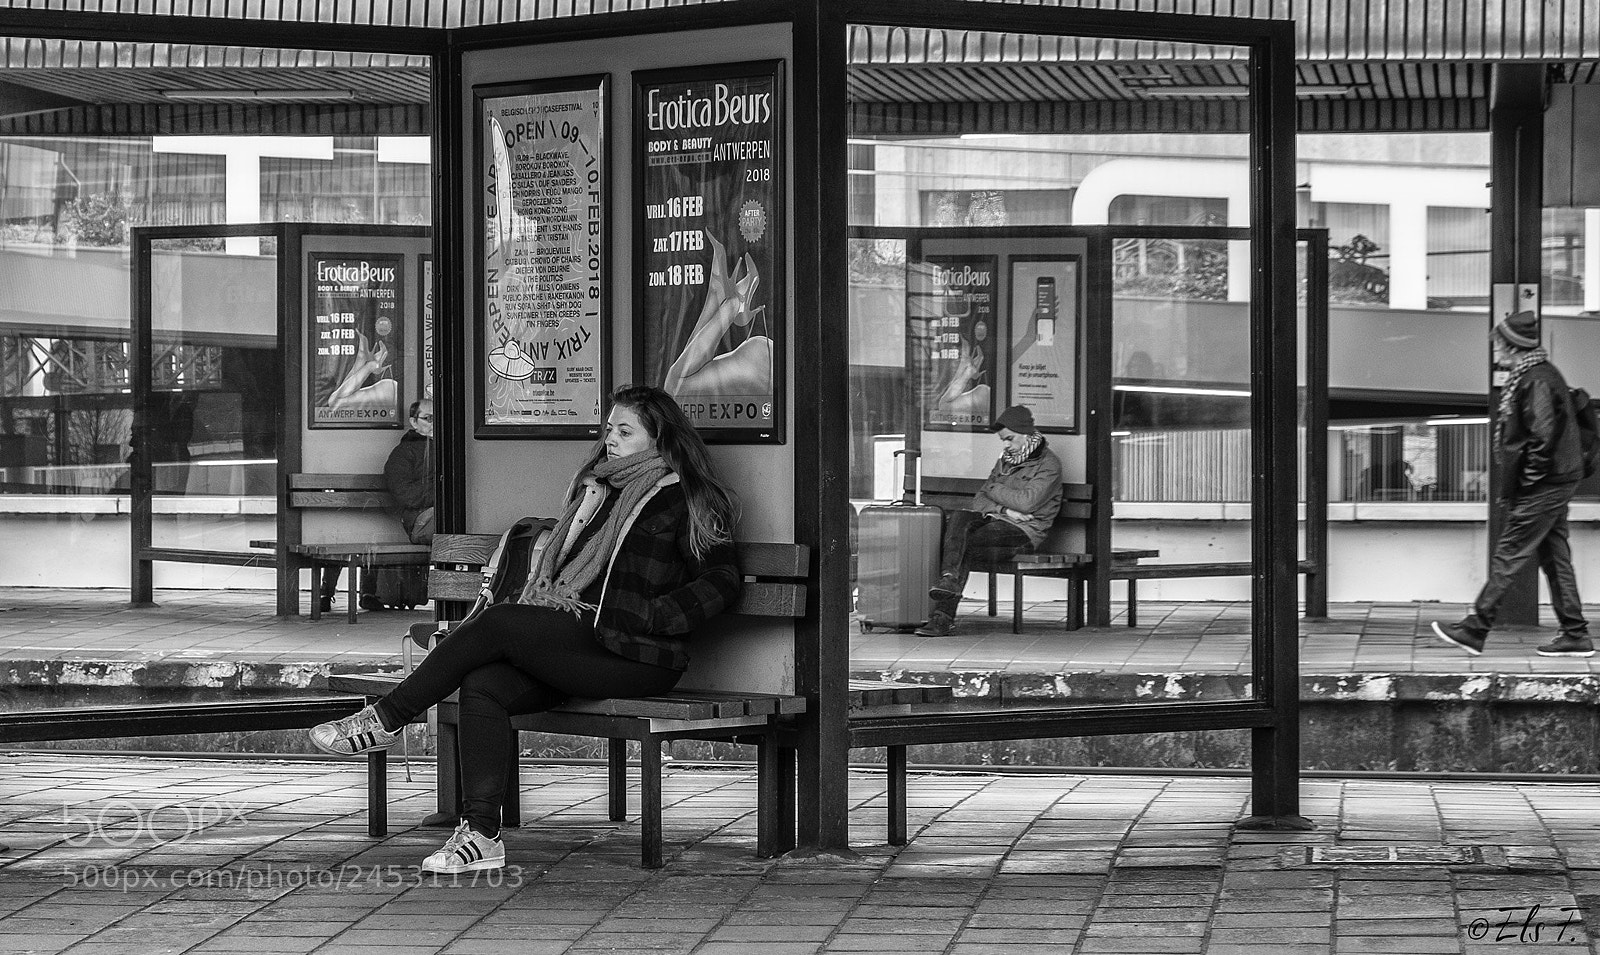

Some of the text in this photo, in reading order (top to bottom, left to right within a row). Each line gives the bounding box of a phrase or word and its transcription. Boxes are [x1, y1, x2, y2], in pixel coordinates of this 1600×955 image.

[504, 119, 547, 149] OPEN
[648, 137, 713, 153] BODY & BEAUTY
[713, 139, 771, 162] ANTWERPEN
[746, 168, 771, 182] 2018
[646, 196, 704, 219] VRIJ. 16 FEB
[744, 209, 761, 217] AFTER
[669, 230, 683, 252] 17
[683, 229, 704, 251] FEB
[667, 264, 683, 286] 18
[684, 264, 704, 286] FEB
[359, 288, 396, 299] ANTWERPEN
[379, 301, 395, 310] 2018
[568, 299, 583, 309] DOG
[341, 312, 356, 324] FEB
[341, 328, 356, 339] FEB
[341, 344, 356, 356] FEB
[318, 409, 387, 420] ANTWERP EXPO
[709, 402, 758, 420] EXPO
